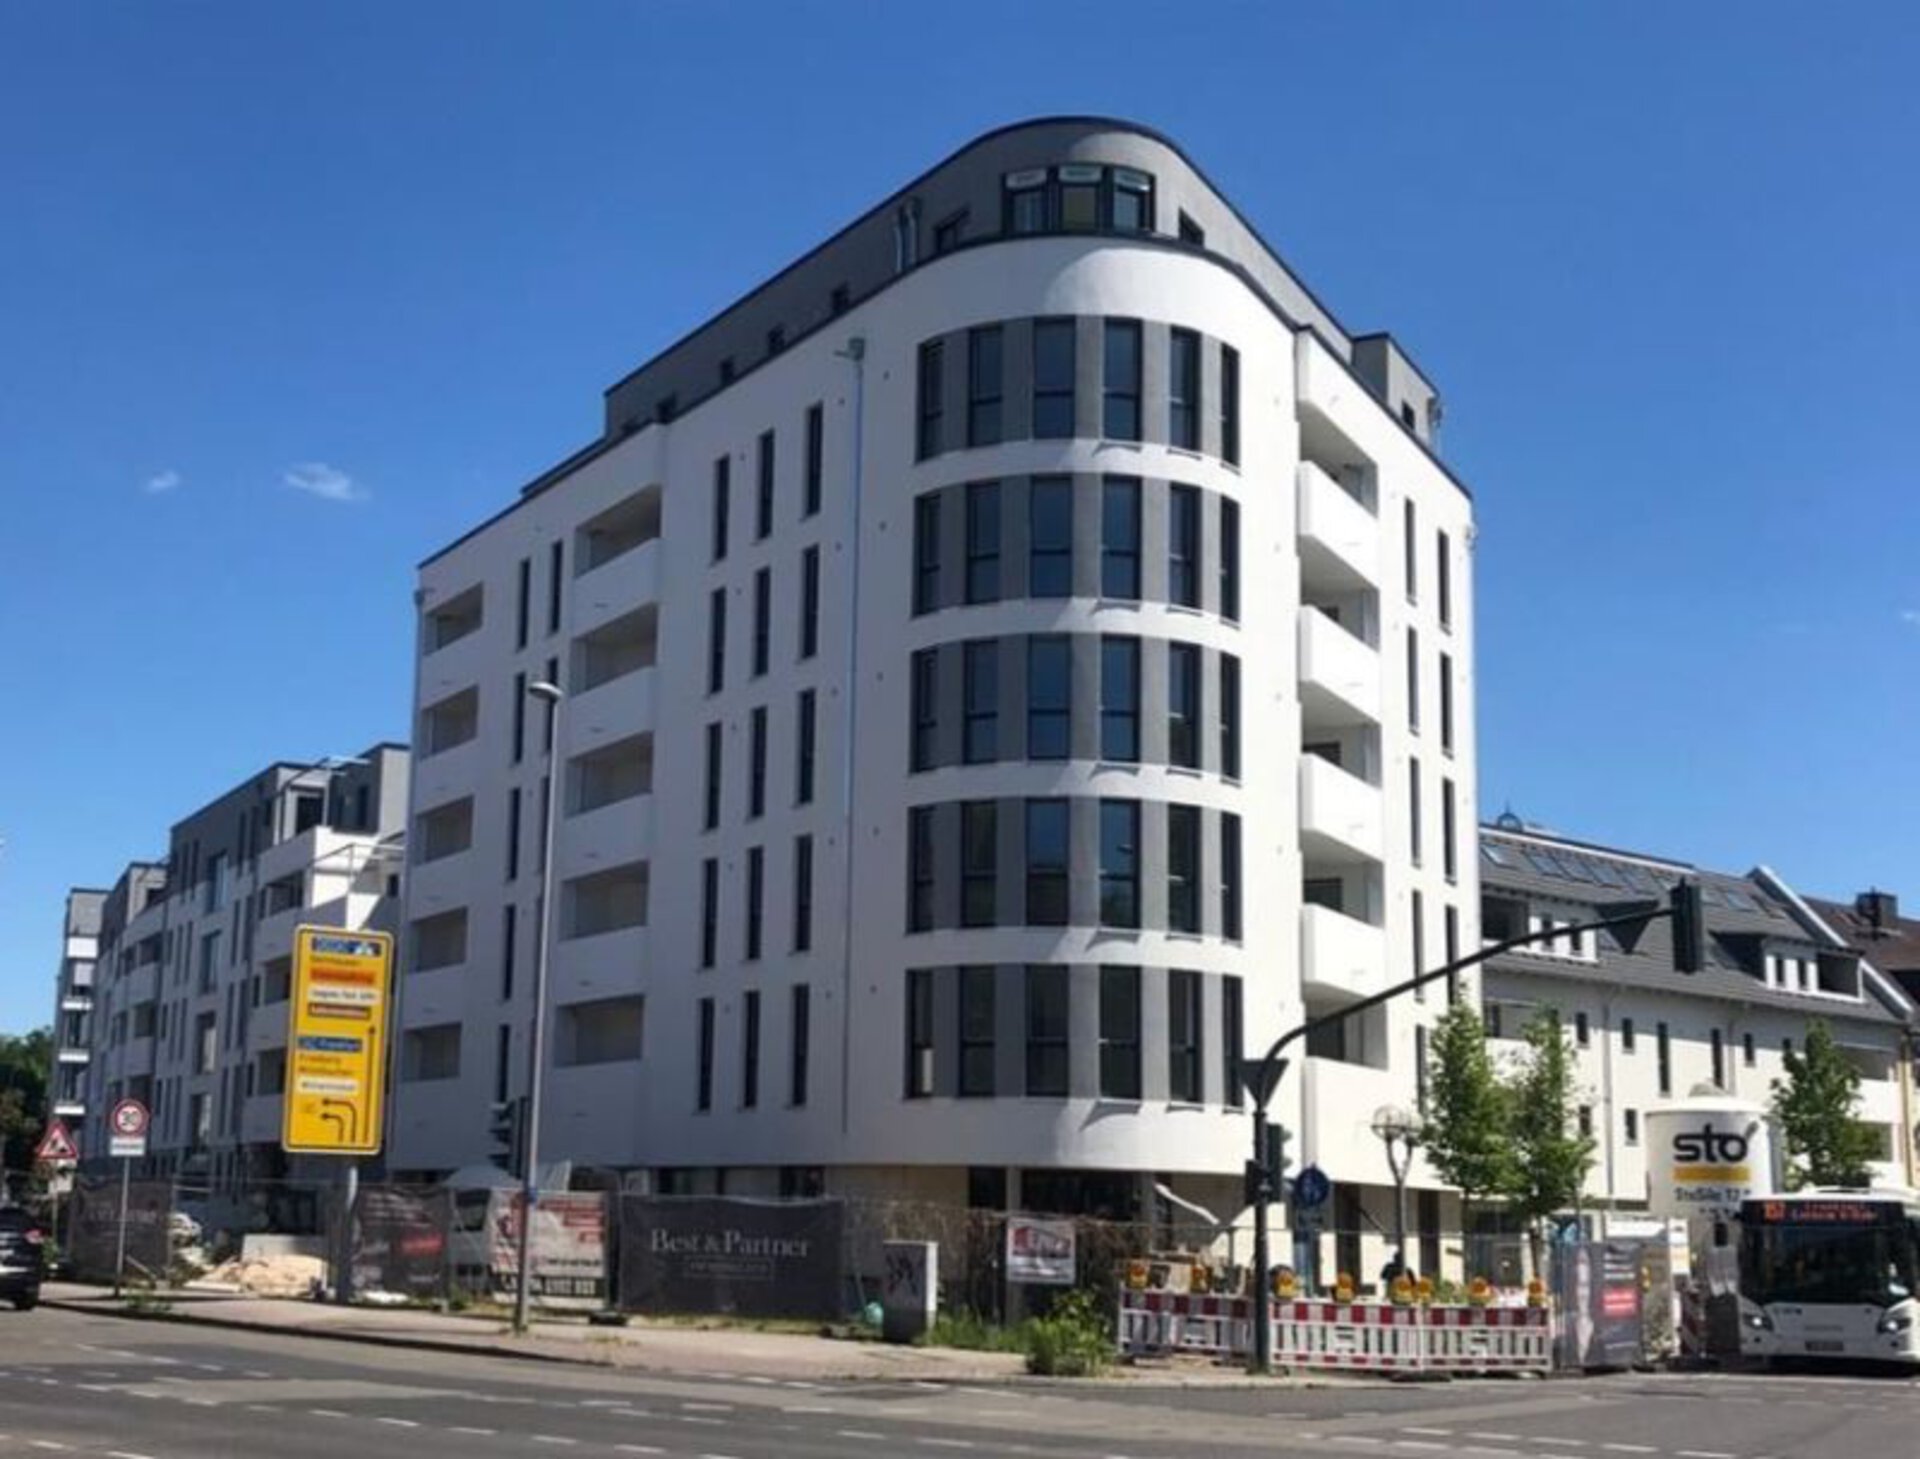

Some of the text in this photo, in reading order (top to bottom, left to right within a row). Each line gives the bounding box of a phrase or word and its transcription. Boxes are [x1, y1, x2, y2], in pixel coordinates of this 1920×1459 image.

[1672, 1122, 1749, 1162] sto
[651, 1228, 808, 1258] Best & Partner
